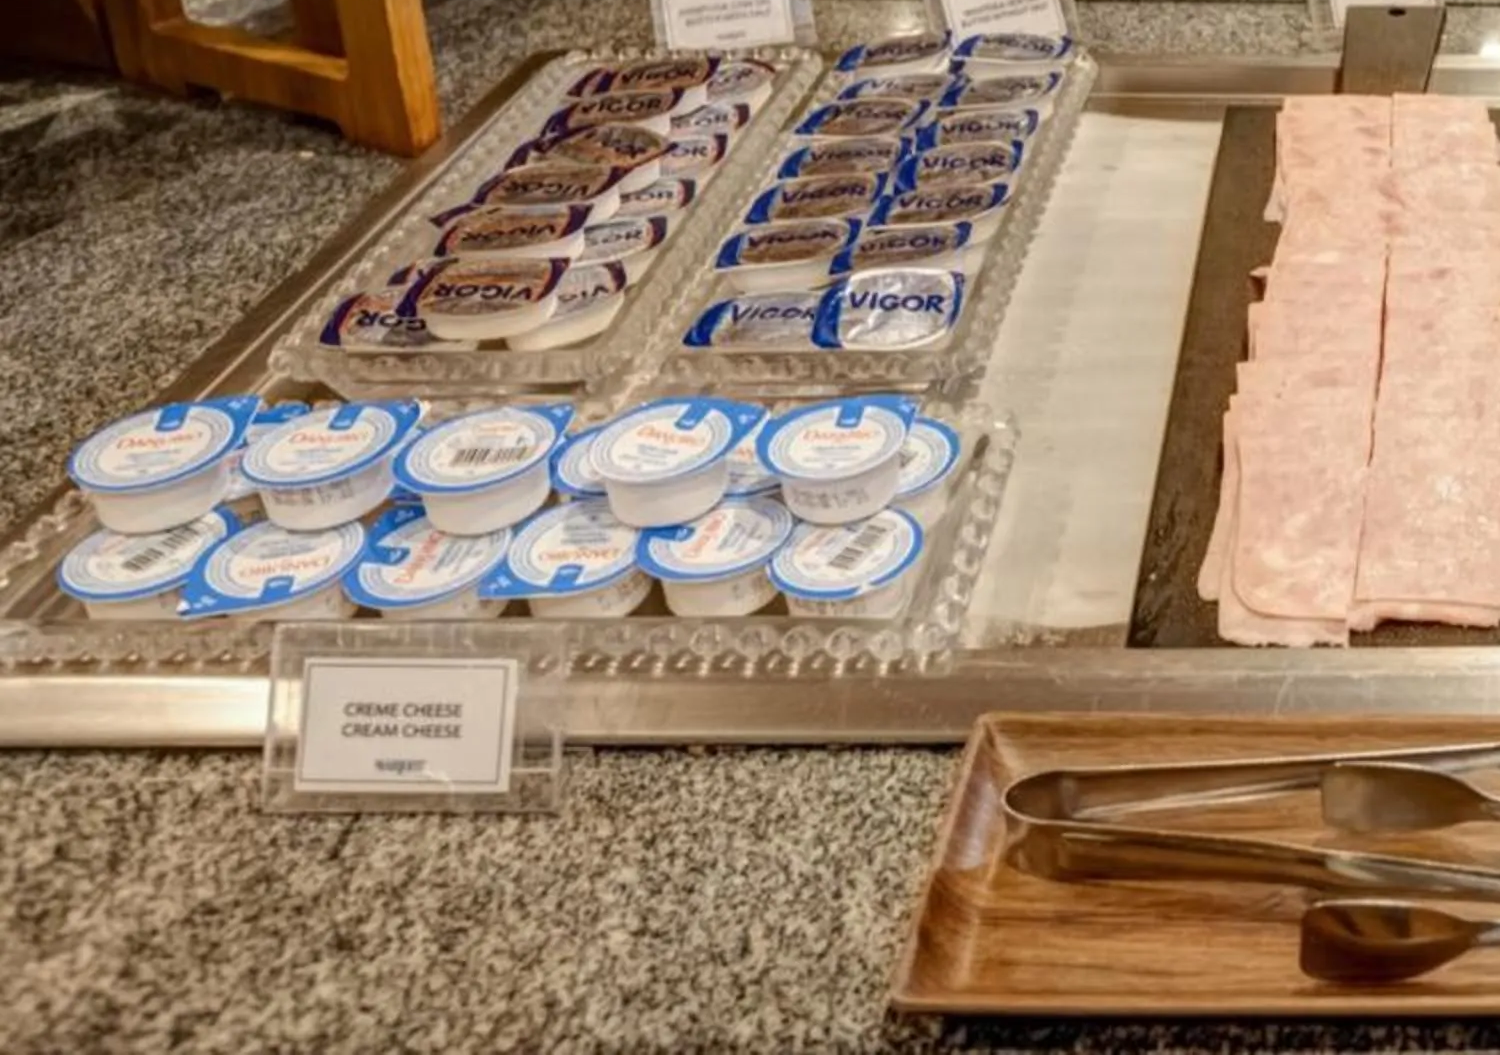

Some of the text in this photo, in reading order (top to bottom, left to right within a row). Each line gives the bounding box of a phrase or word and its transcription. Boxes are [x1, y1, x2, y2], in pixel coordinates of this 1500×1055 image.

[580, 97, 662, 114] VIGOR
[923, 153, 1007, 171] VIGOR
[502, 180, 589, 196] VIGOR
[782, 183, 867, 203] VIGOR
[900, 194, 984, 210] VIGOR
[861, 234, 947, 252] VIGOR
[433, 282, 533, 300] VIGOR
[850, 291, 945, 314] VIGOR
[343, 703, 463, 719] CREME CHEESE
[341, 723, 463, 739] CREAM CHEESE
